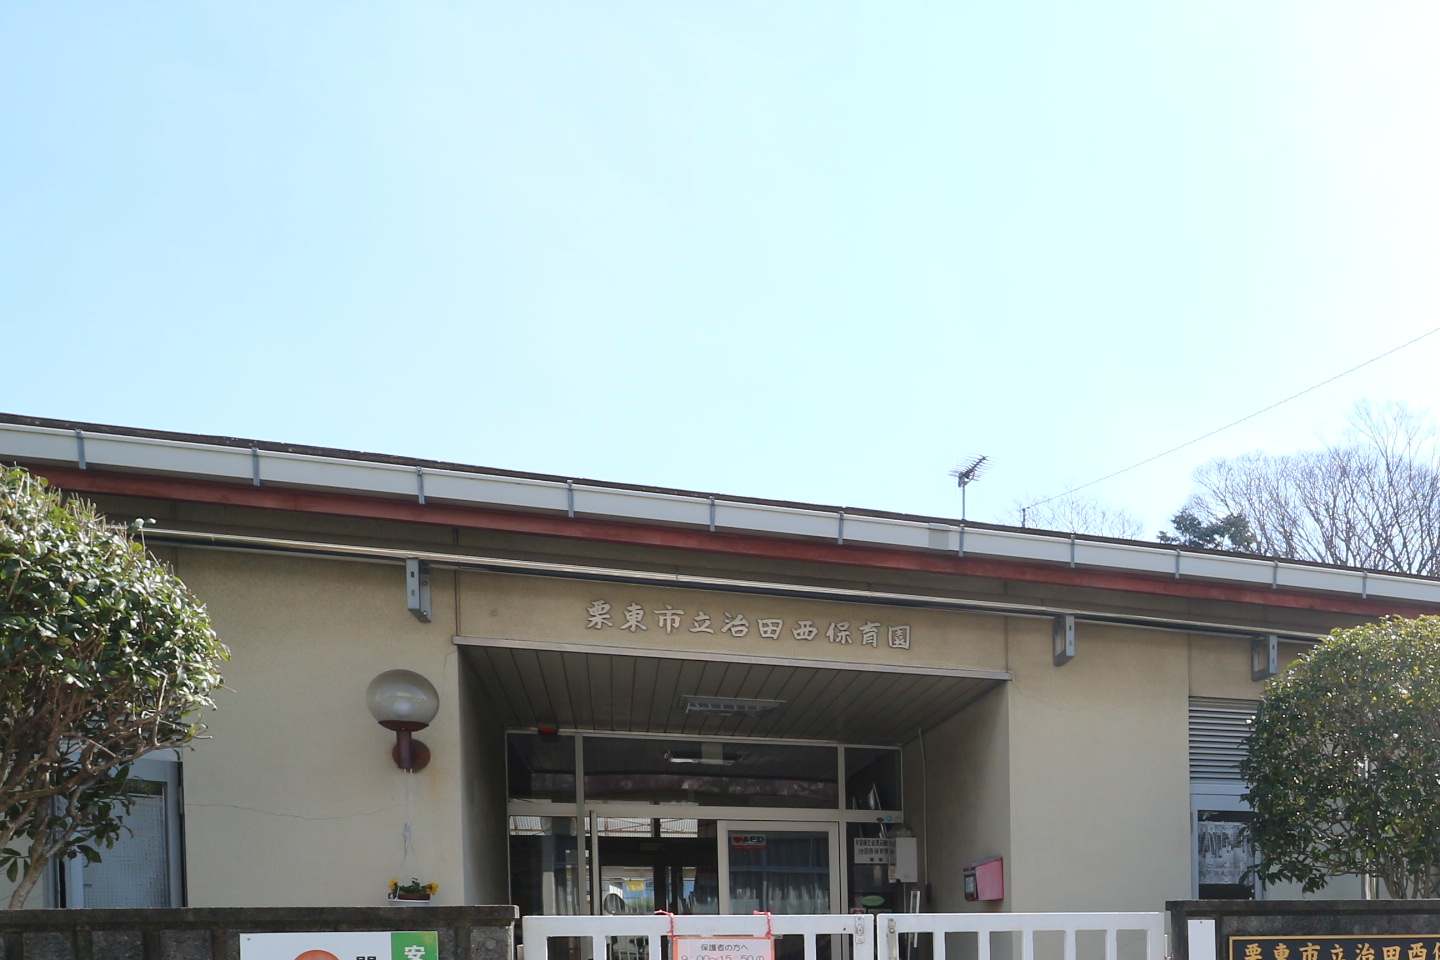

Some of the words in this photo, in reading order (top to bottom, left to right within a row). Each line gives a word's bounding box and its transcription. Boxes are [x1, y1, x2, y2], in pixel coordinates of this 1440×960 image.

[586, 600, 912, 650] 栗東市立治田西保育園
[700, 944, 749, 952] 保護者の方へ
